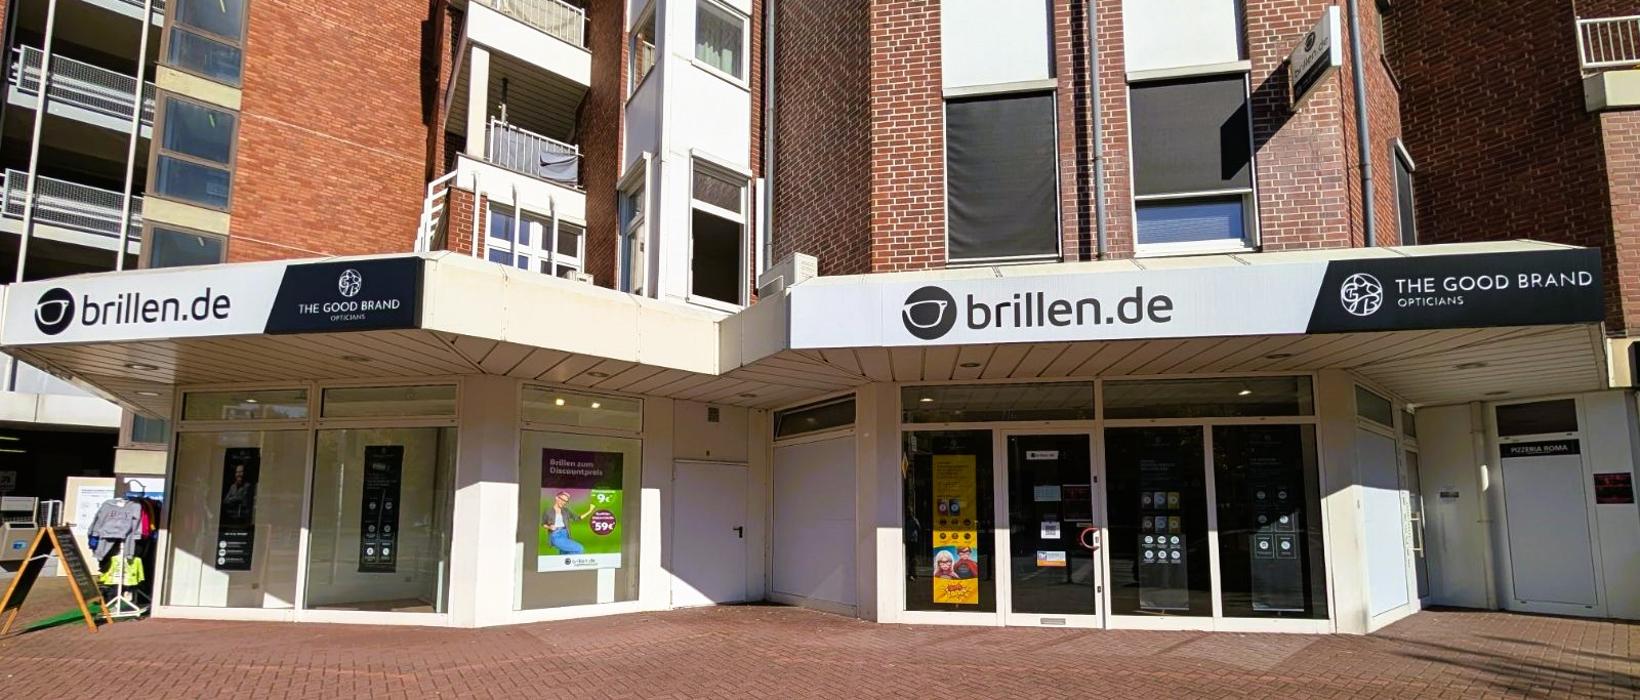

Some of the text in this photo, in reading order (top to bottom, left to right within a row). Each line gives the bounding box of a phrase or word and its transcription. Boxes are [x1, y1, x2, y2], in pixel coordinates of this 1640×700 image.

[1395, 271, 1593, 294] THE GOOD BRAND
[81, 287, 231, 326] brillen.de
[298, 299, 401, 314] THE GOOD BRAND
[966, 286, 1174, 330] brillen.de
[1397, 296, 1464, 308] OPTICIANS
[330, 314, 366, 322] OPTICIANS
[1543, 444, 1569, 452] ROMA
[549, 458, 576, 467] Brillen
[549, 467, 604, 477] Discountpreis
